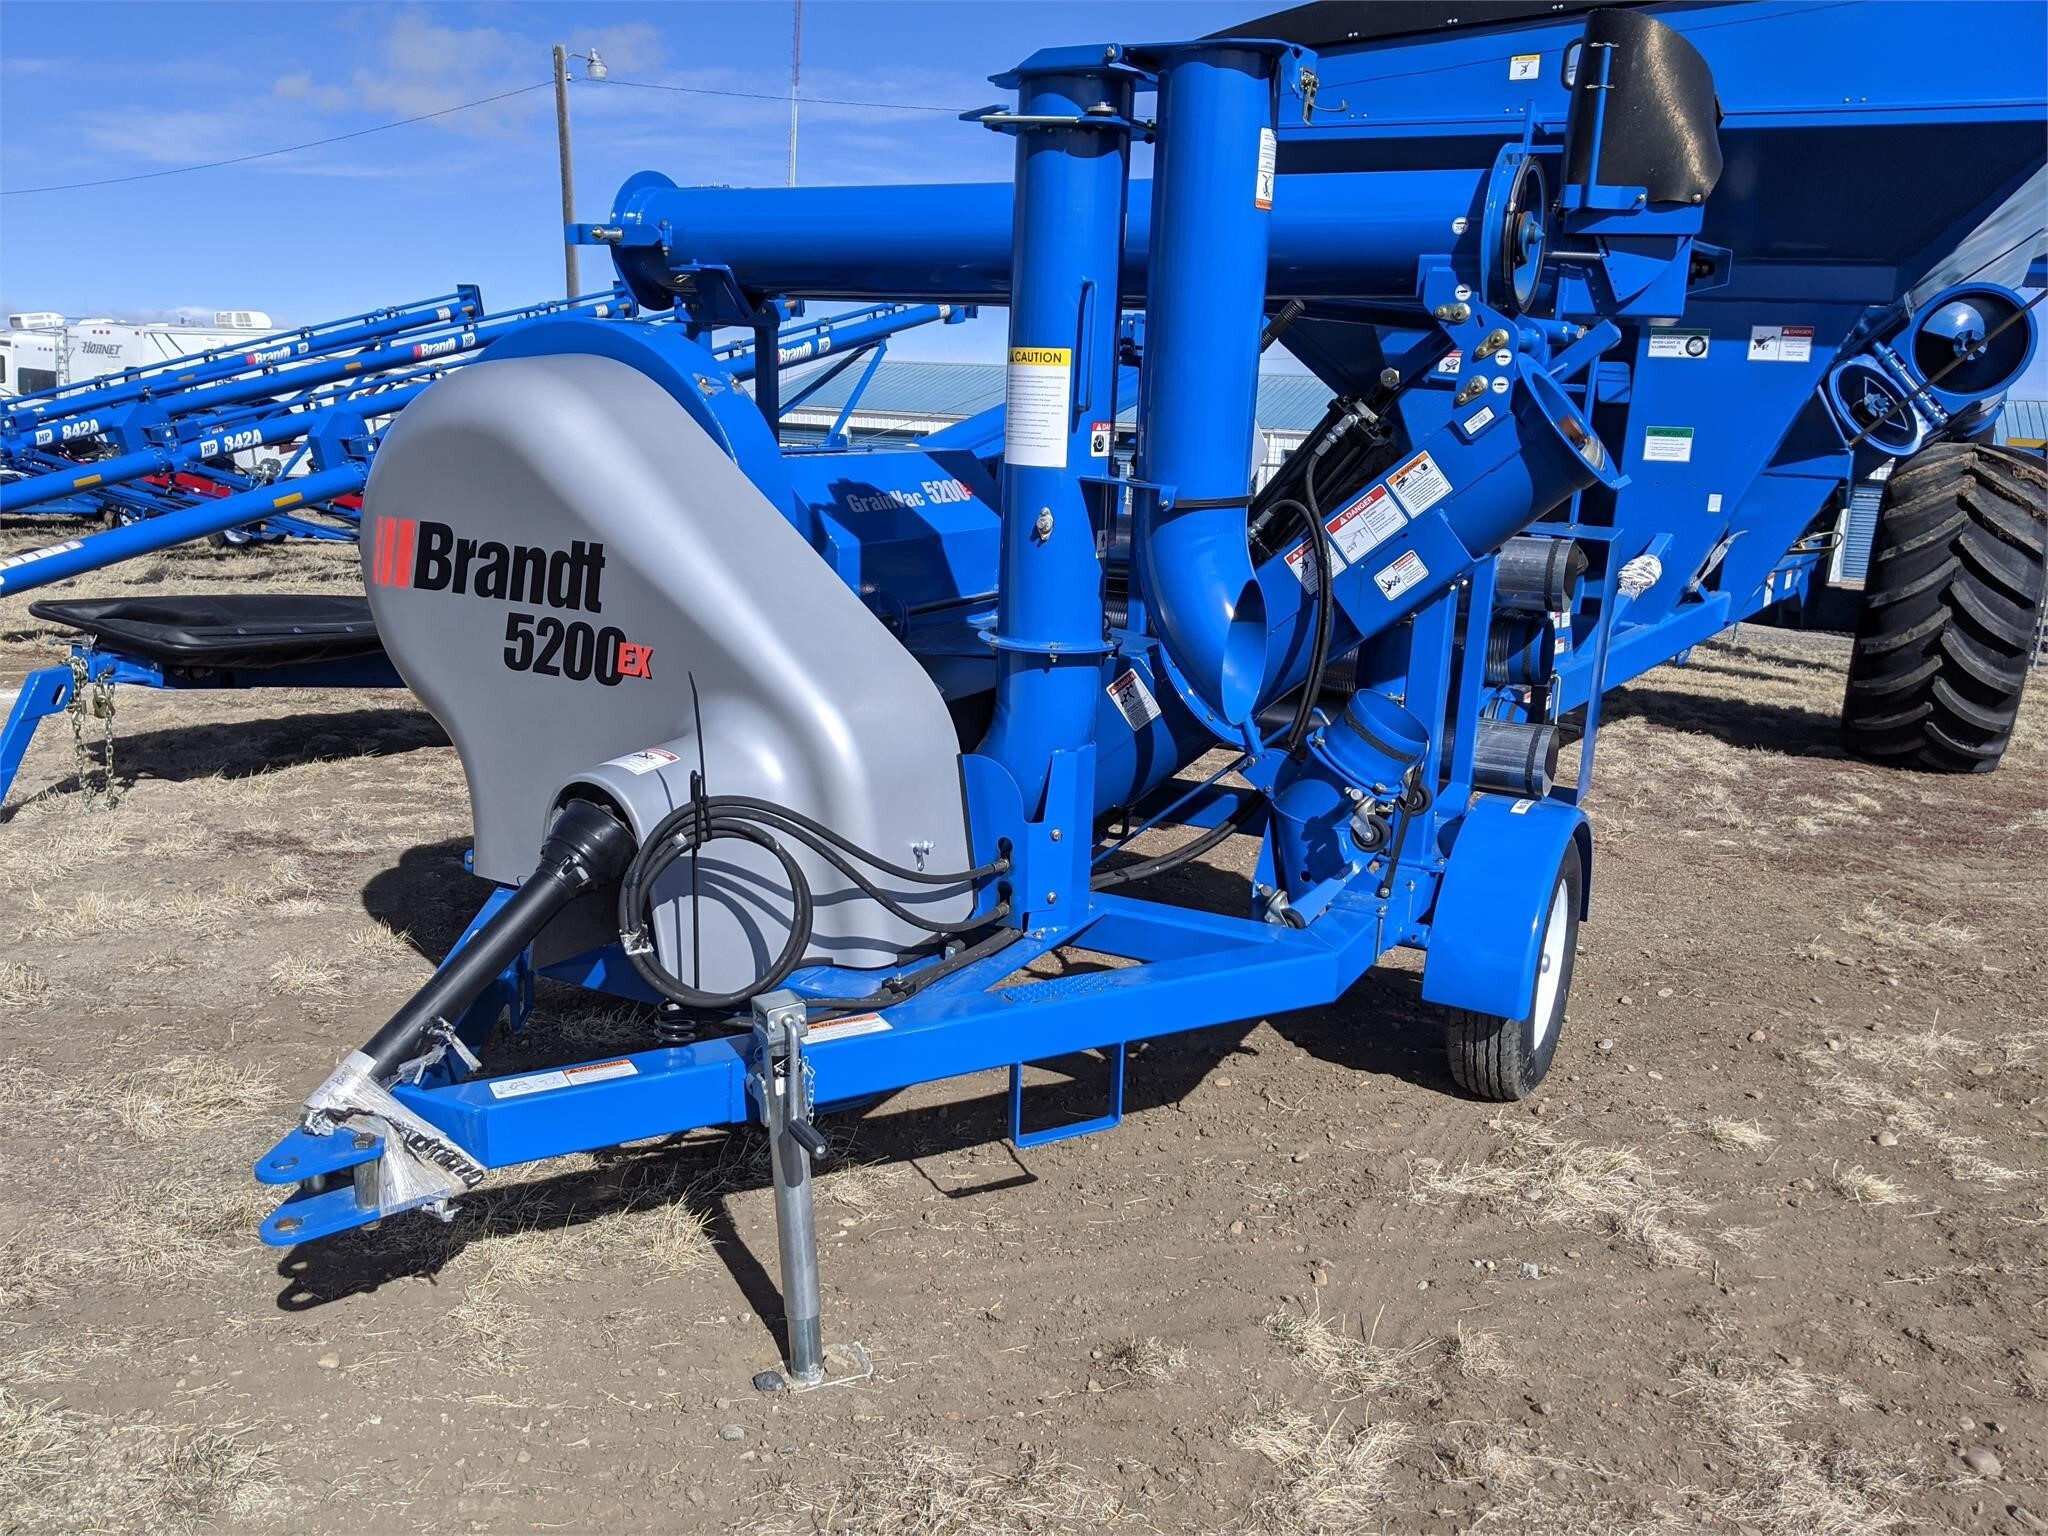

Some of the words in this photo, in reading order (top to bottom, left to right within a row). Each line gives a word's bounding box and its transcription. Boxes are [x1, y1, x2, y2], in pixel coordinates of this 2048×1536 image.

[81, 341, 123, 355] HORNET
[254, 346, 291, 363] Brandt
[421, 337, 456, 357] Brandt
[779, 341, 812, 362] Brandt
[1014, 351, 1062, 363] CAUTION
[38, 431, 51, 442] HP
[62, 419, 99, 440] 842A
[203, 443, 216, 454] HP
[223, 429, 262, 453] 842A
[846, 490, 925, 513] GrainVac
[920, 478, 971, 504] 5200
[1345, 495, 1374, 519] DANGER
[413, 520, 606, 614] Brandt
[818, 1014, 864, 1029] WARNING
[577, 1059, 625, 1072] WARNING
